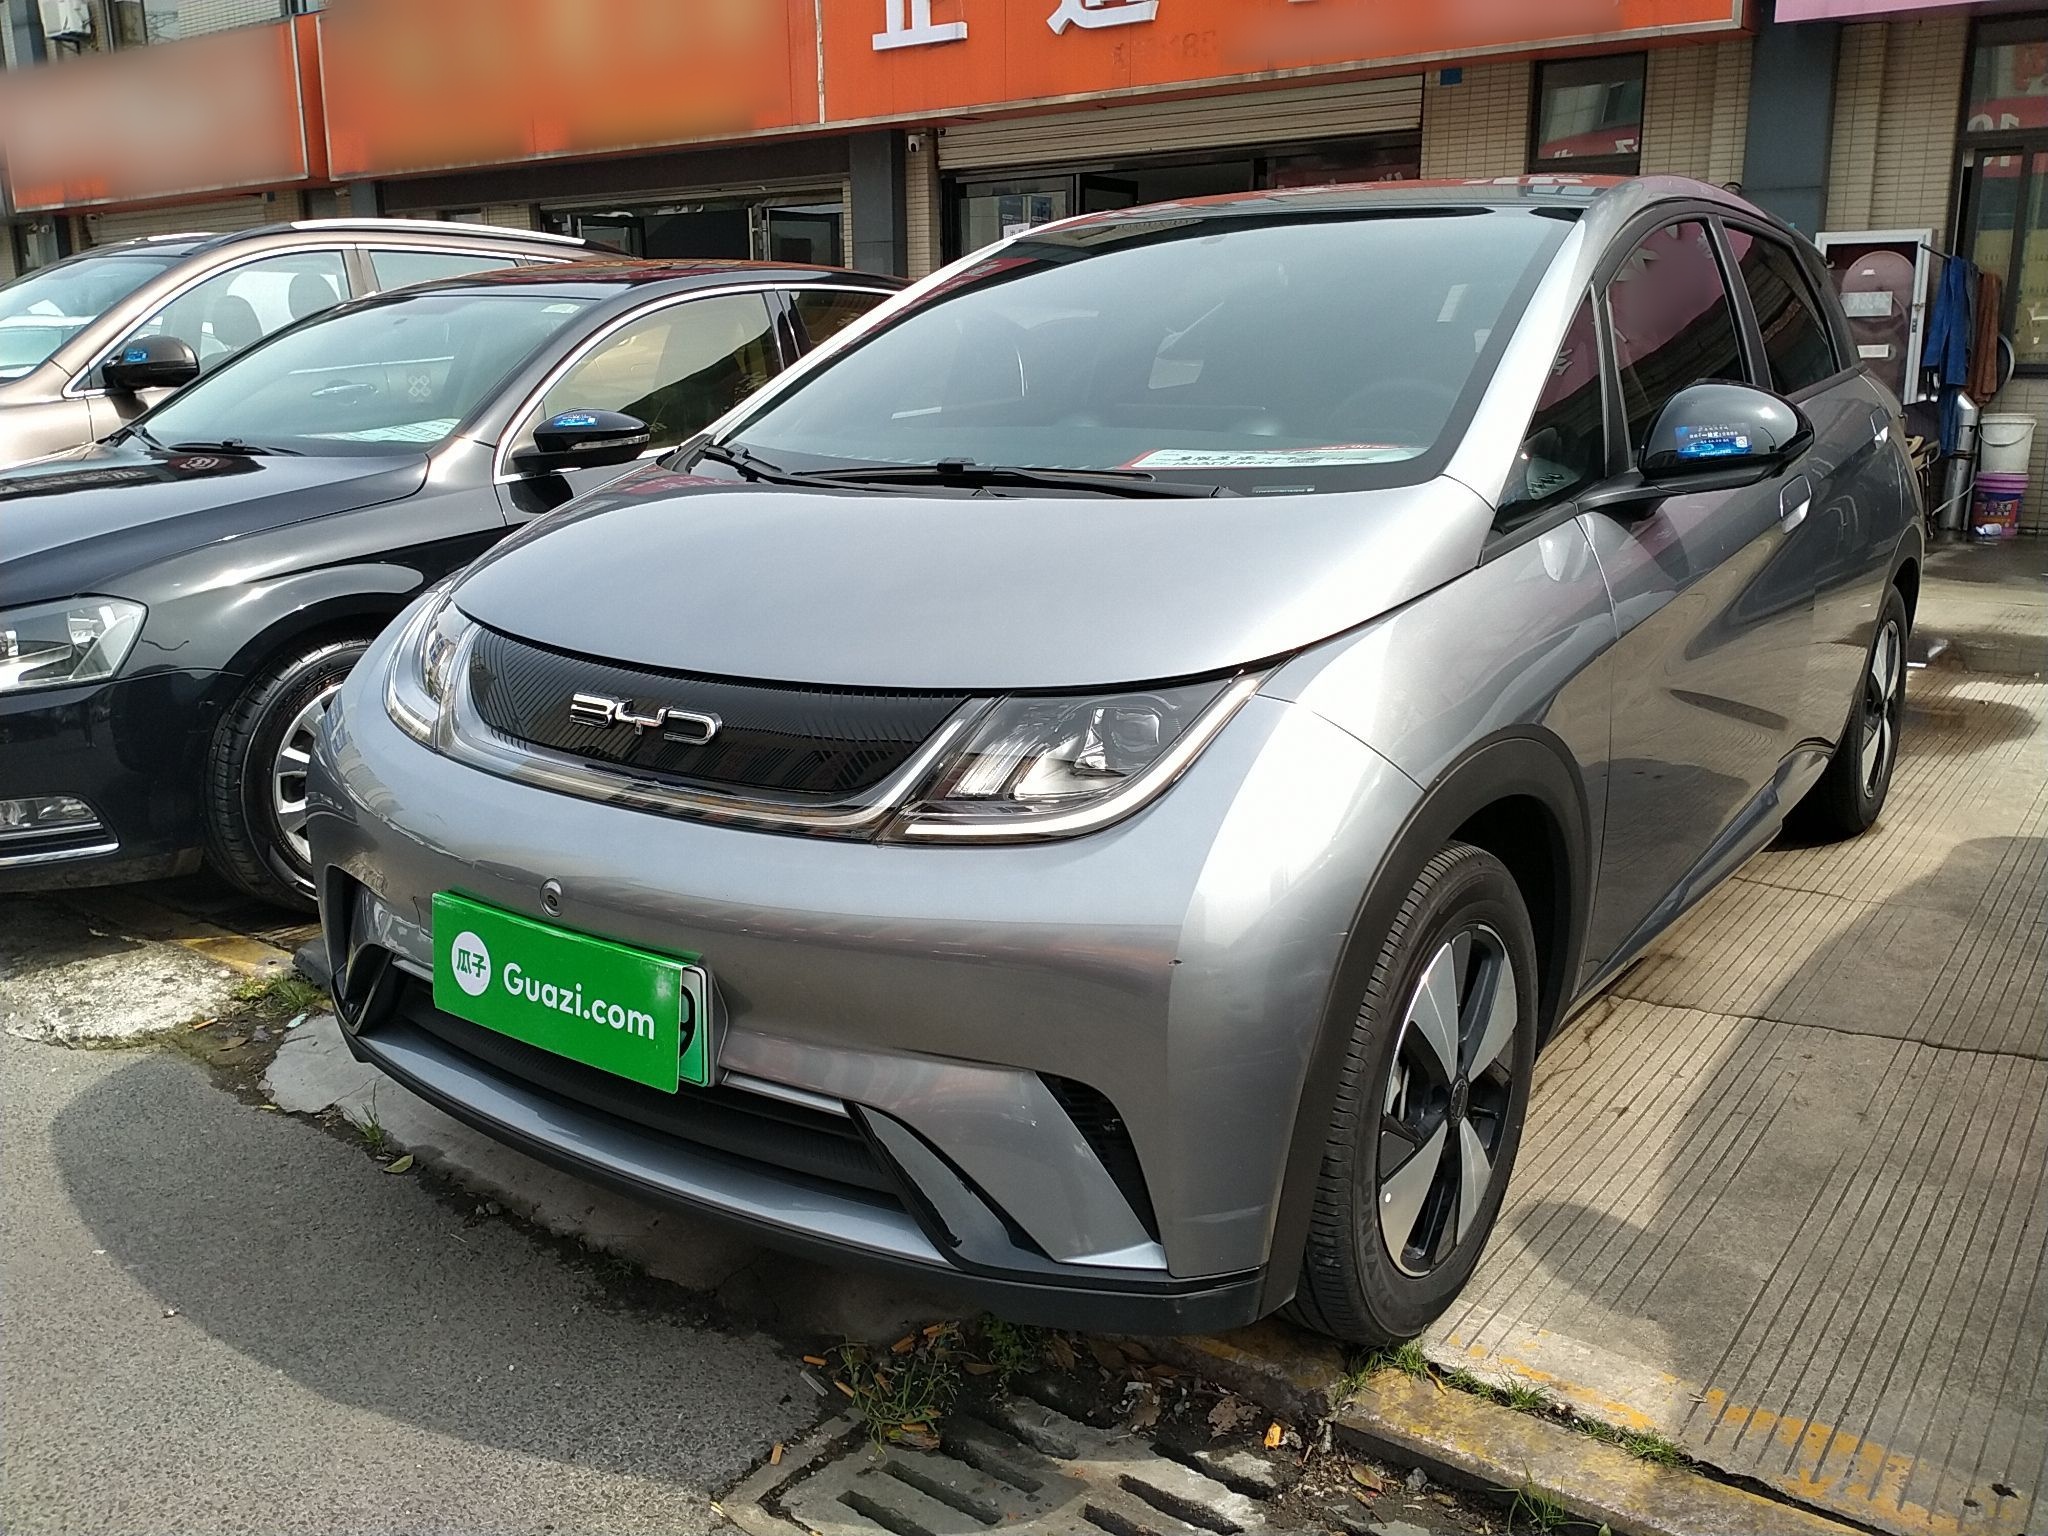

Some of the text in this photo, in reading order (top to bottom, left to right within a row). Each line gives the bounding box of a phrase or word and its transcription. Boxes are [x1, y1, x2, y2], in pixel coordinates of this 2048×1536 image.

[569, 690, 723, 746] BYD
[456, 947, 487, 979] 瓜子
[502, 962, 656, 1040] Guazi.com
